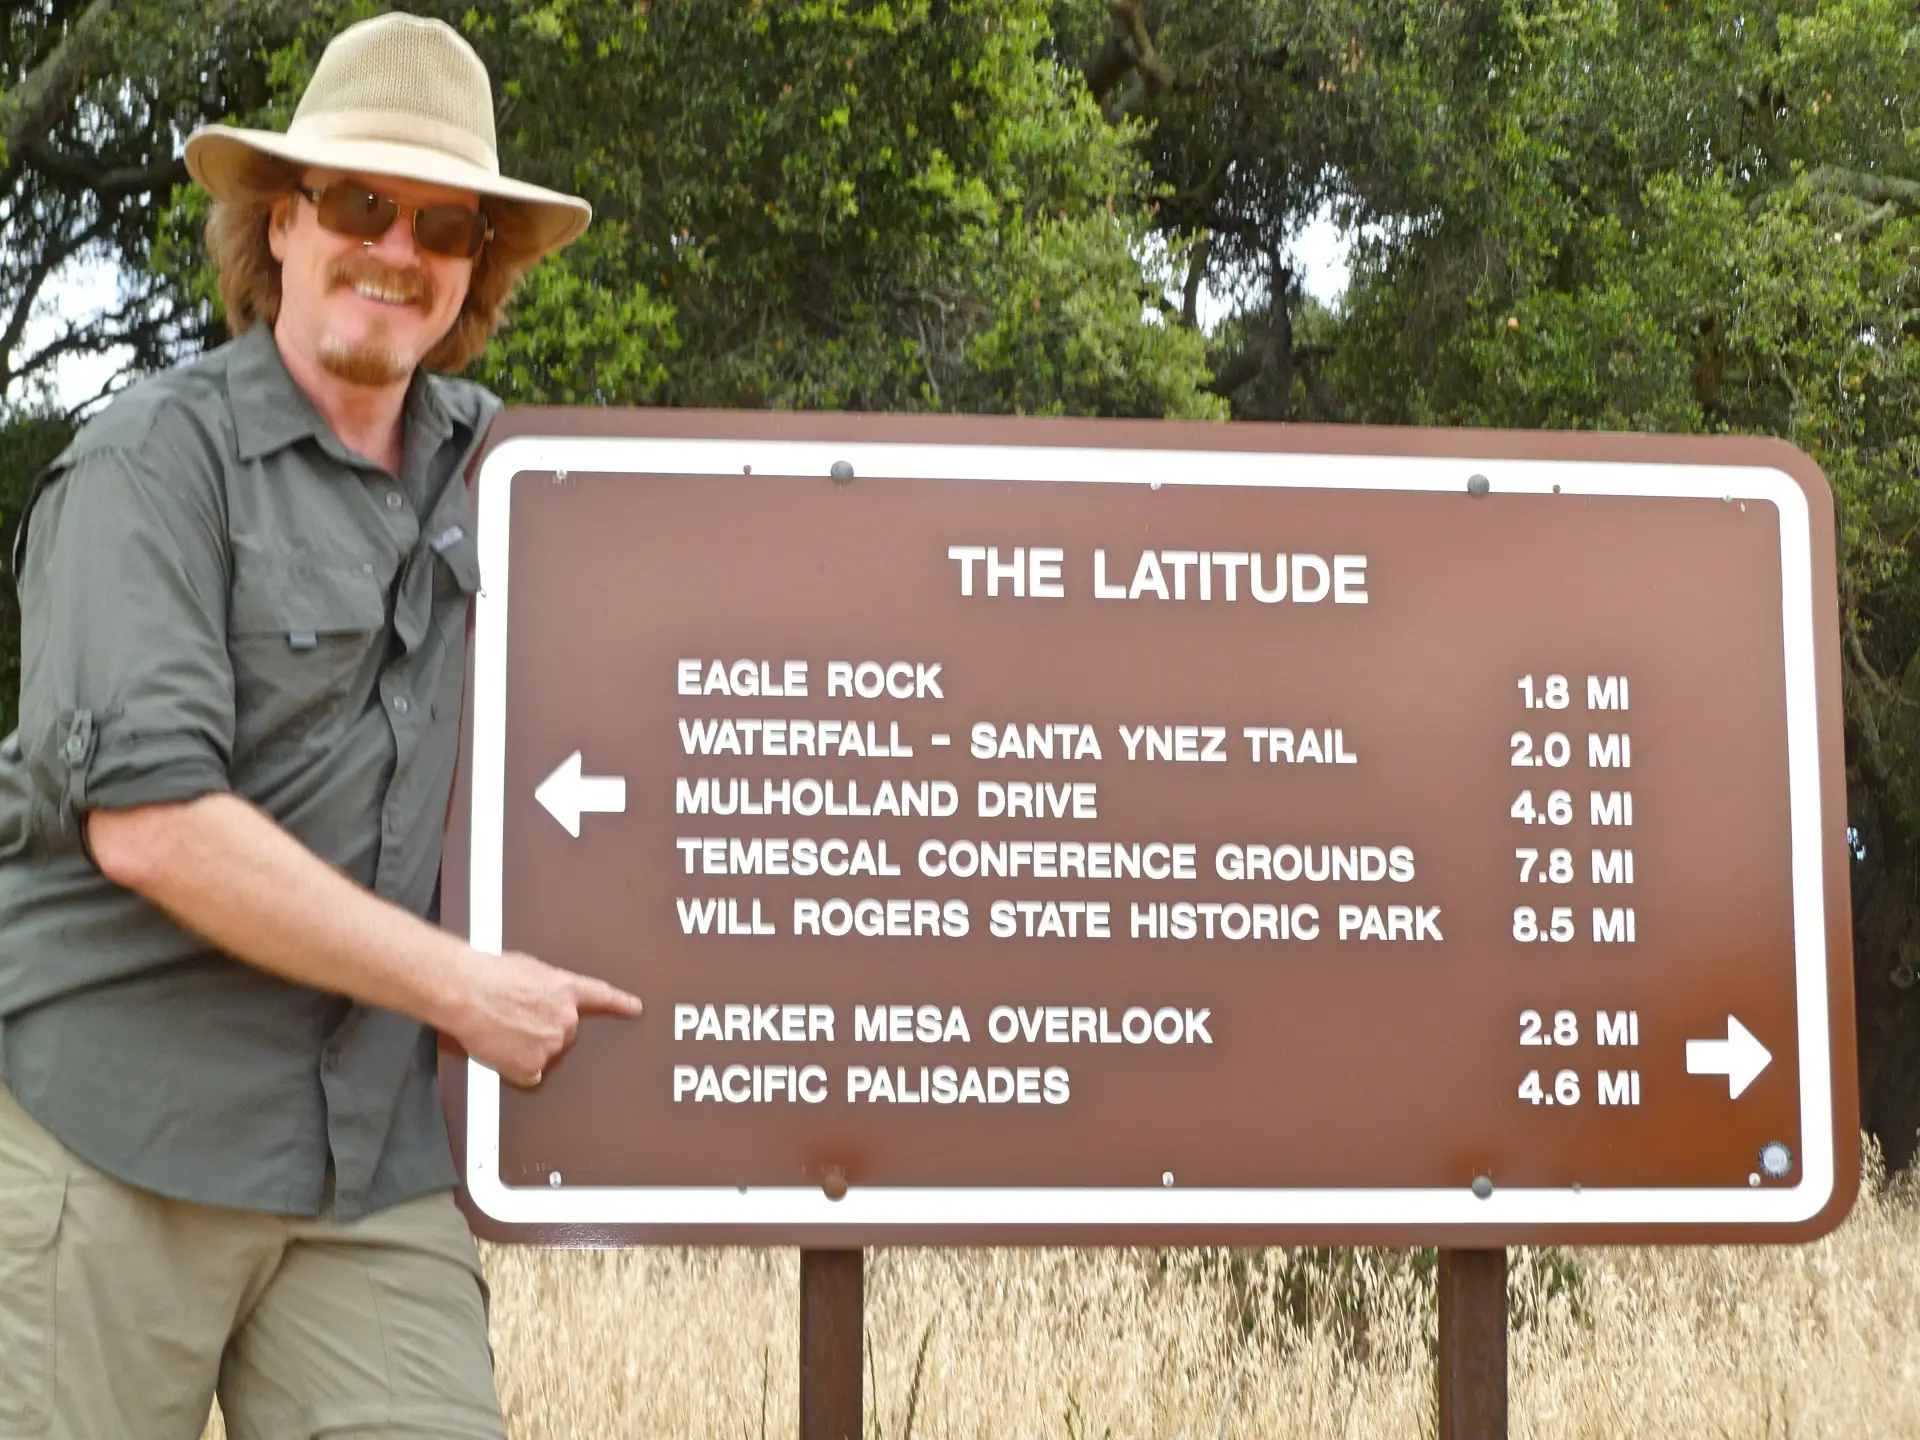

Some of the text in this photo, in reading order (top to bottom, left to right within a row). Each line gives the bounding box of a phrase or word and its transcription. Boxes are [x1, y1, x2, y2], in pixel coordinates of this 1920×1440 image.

[948, 546, 1368, 604] THE LATITUDE
[678, 658, 1629, 711] EAGLE ROCK 1.8 MI
[677, 718, 914, 757] WATERFALL
[970, 722, 1103, 760] SANTA
[1118, 725, 1227, 762] YNEZ
[1243, 727, 1358, 764] TRAIL
[1510, 732, 1570, 768] 2.0
[1588, 733, 1631, 768] MI
[676, 777, 1633, 826] MULHOLLAND DRIVE 4.6 MI
[676, 837, 1634, 884] TEMESCAL CONFERENCE GROUNDS 7.8 MI
[676, 897, 1636, 943] WILL ROGERS STATE HISTORIC PARK 8.5 MI
[674, 1003, 1639, 1046] PARKER MESA OVERLOOK 2.8 MI
[673, 1064, 1640, 1106] PACIFIC PALISADES 4.6 MI
